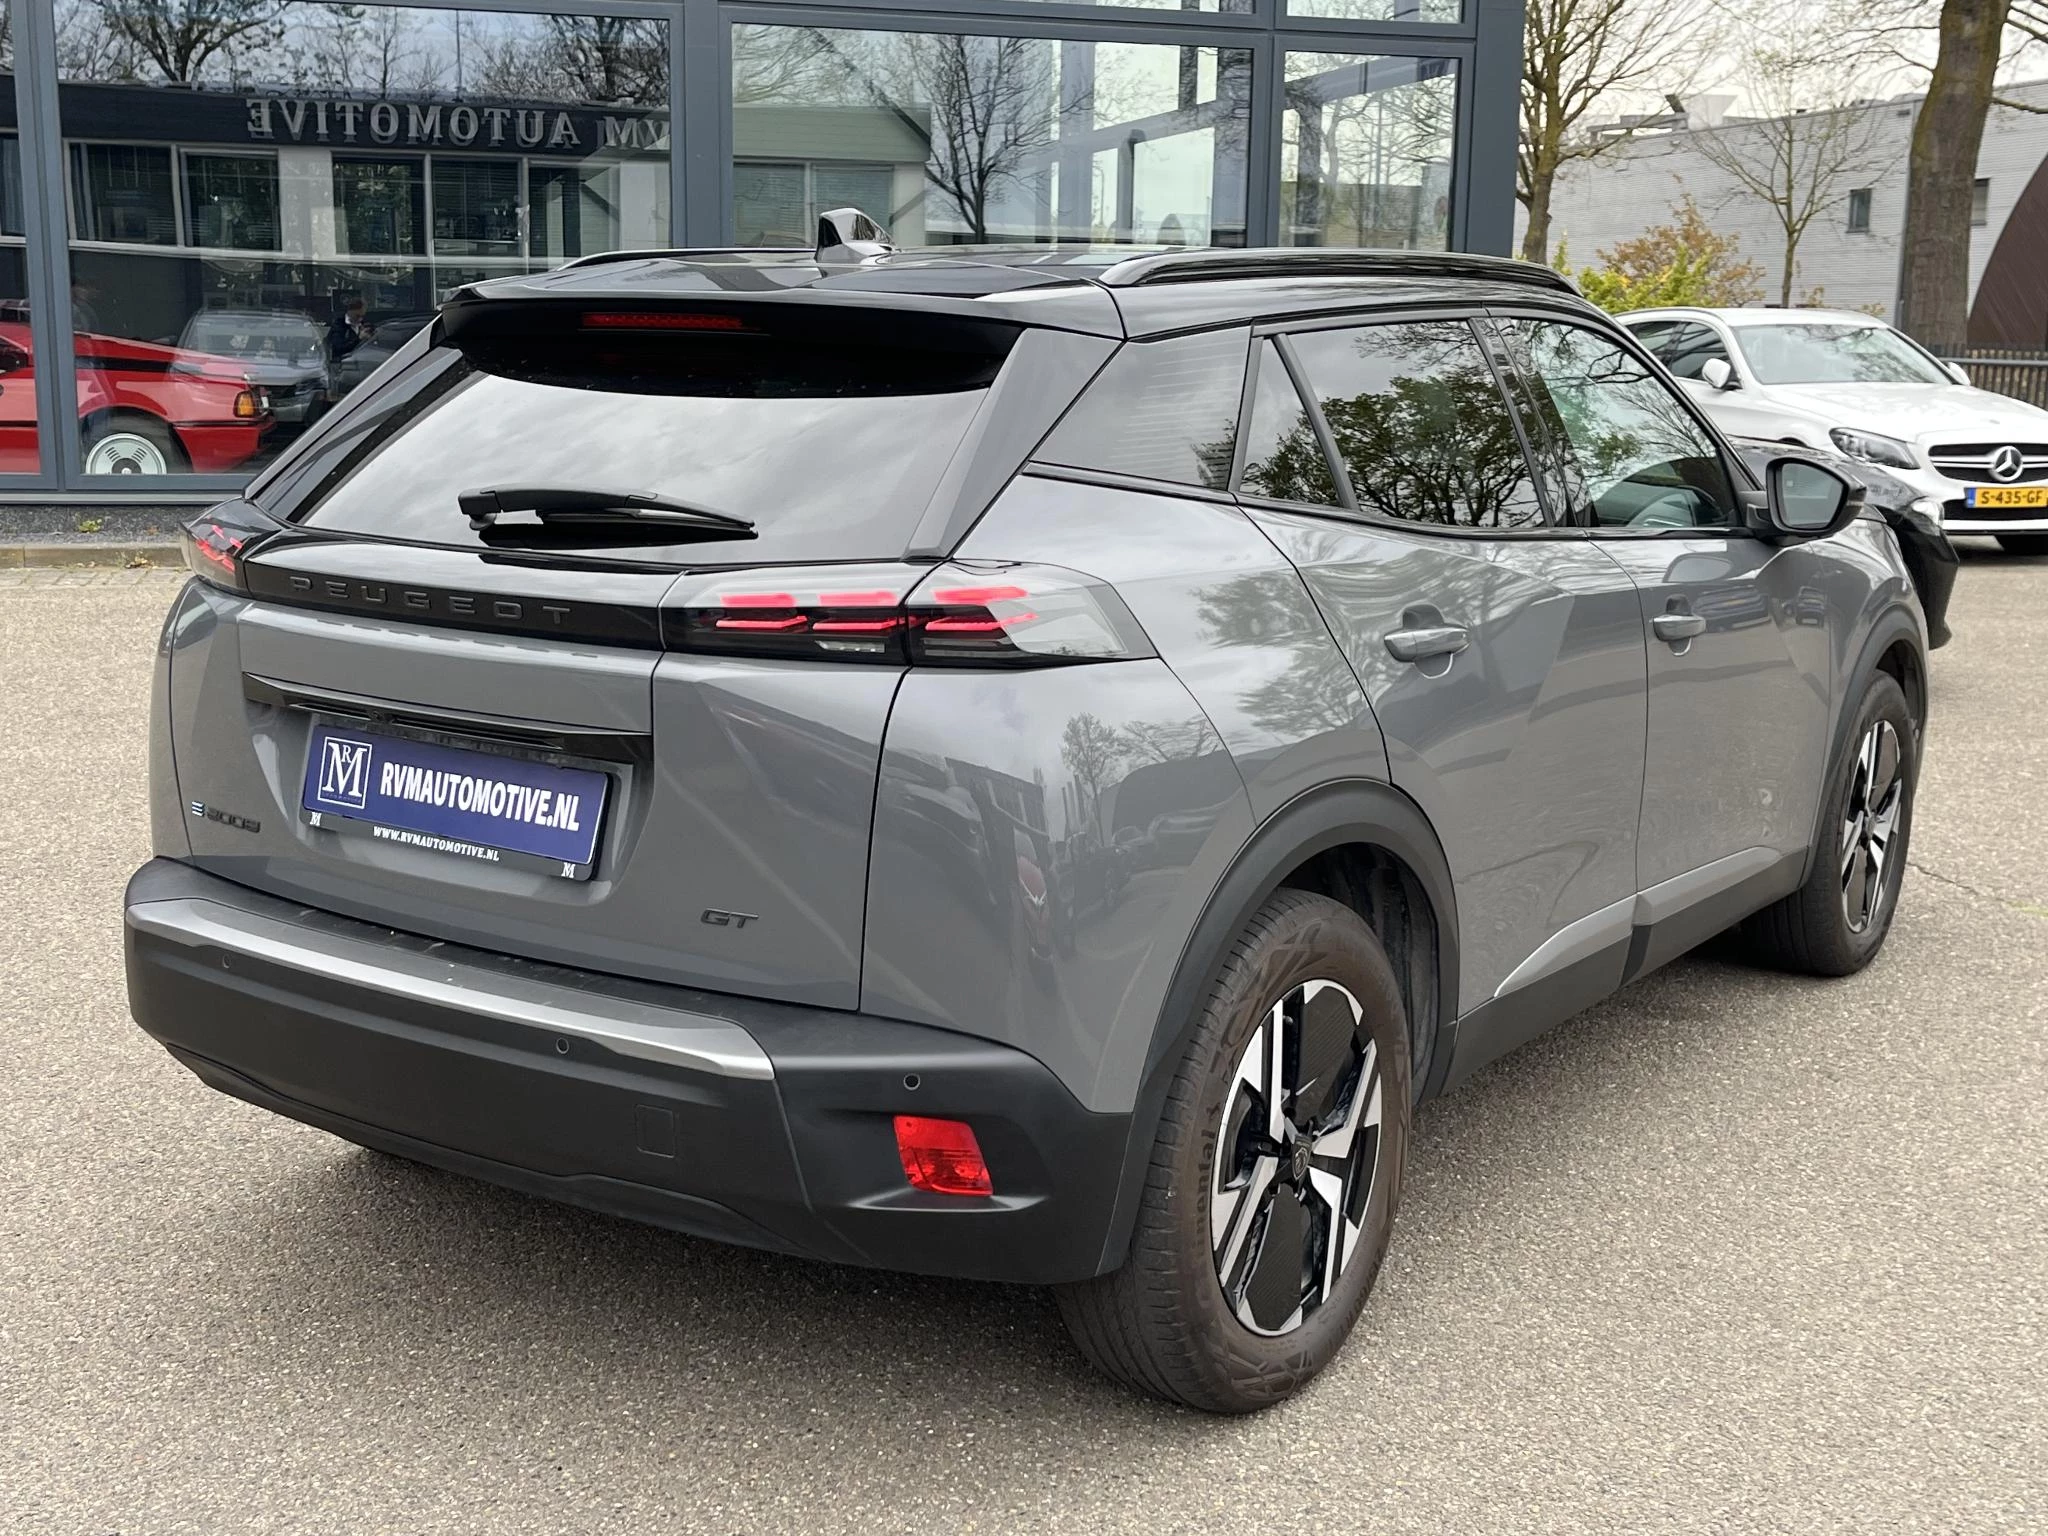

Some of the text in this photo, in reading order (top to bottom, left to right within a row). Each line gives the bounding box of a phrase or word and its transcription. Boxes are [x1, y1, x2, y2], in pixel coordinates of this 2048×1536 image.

[1981, 490, 2043, 504] S-435-GF
[289, 576, 571, 624] PEUGEOT
[380, 762, 580, 831] RVMAUTOMOTIVE.NL
[700, 907, 759, 928] GT
